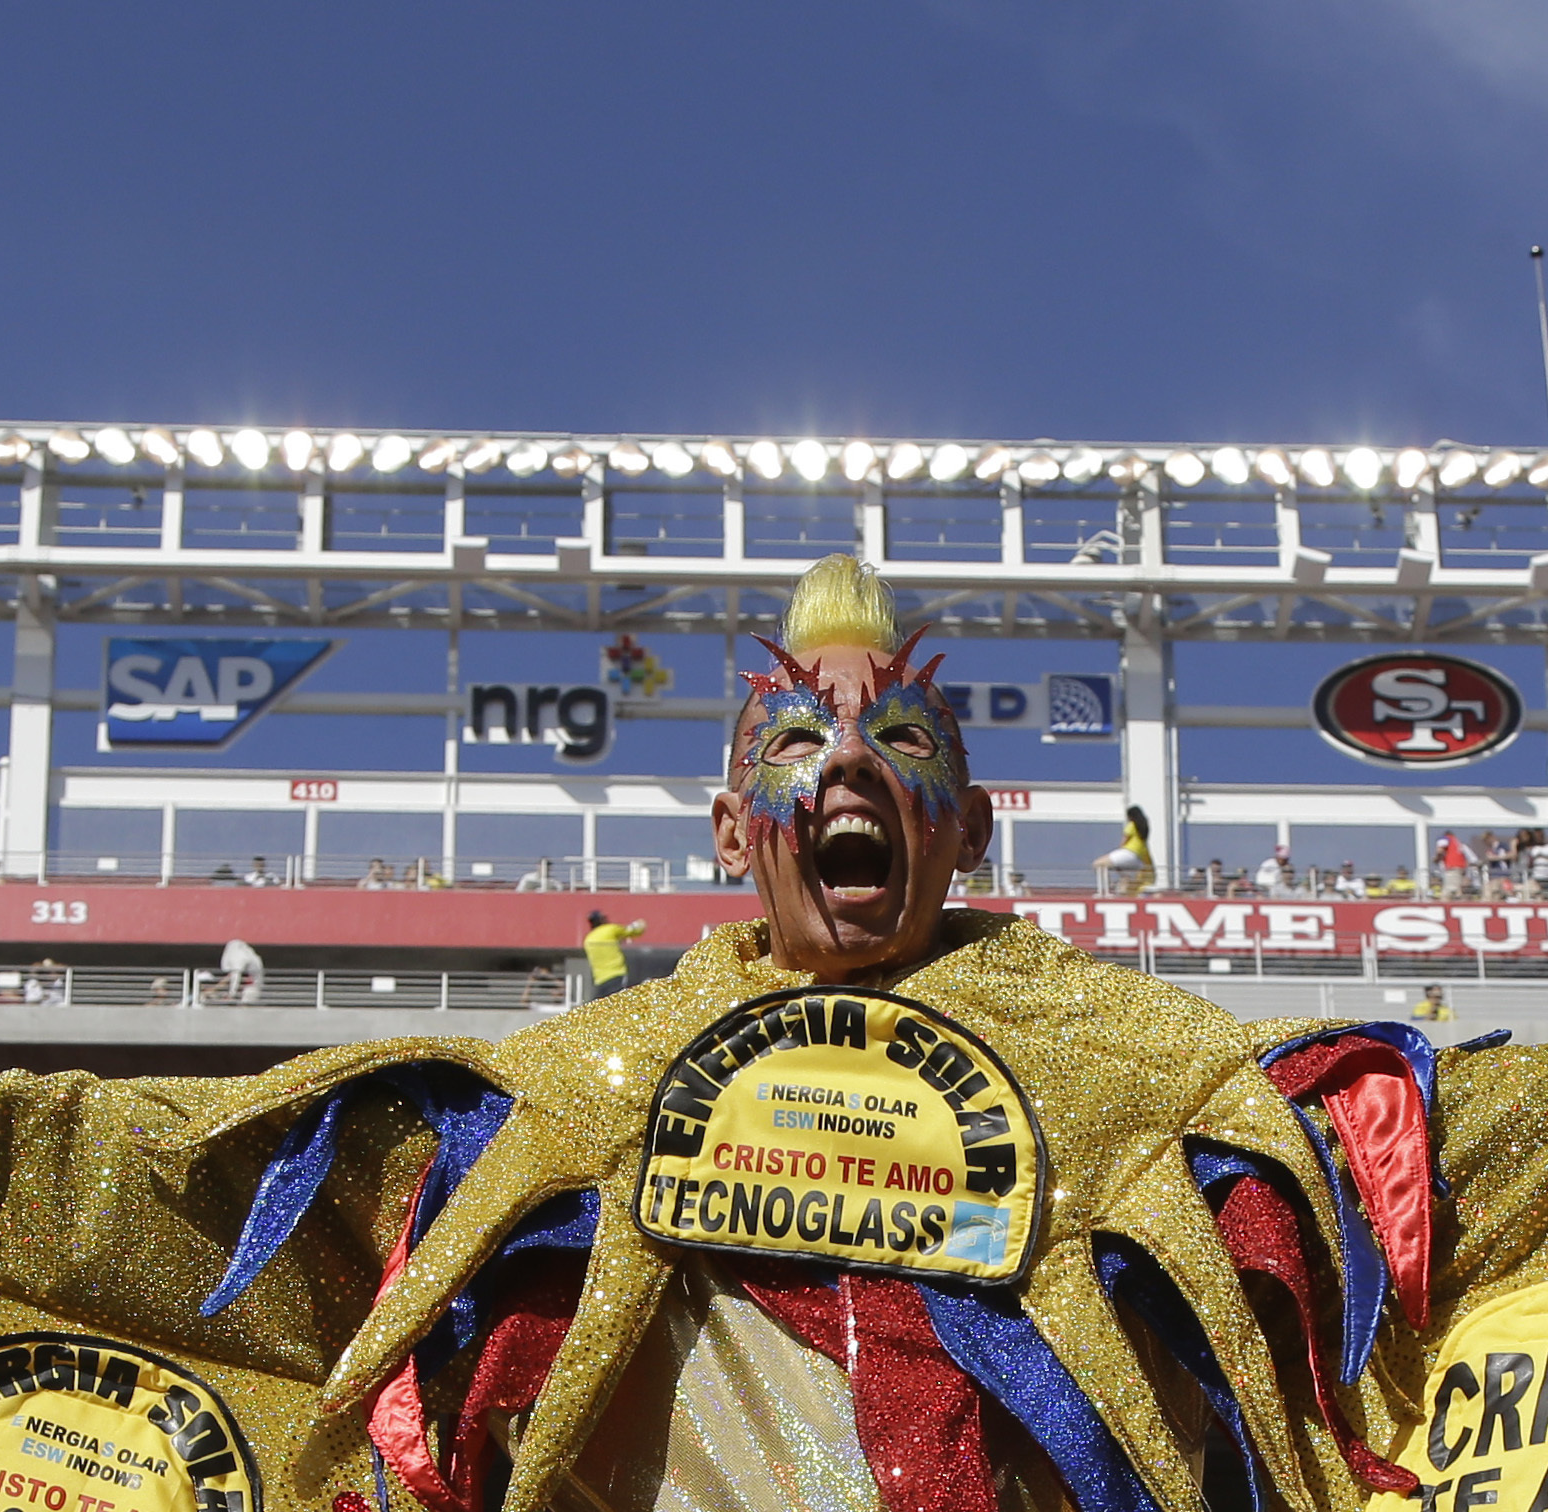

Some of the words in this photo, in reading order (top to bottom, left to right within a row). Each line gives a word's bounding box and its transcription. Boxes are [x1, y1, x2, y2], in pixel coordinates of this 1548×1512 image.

[108, 655, 273, 721] SAP
[471, 684, 608, 757] nrg
[293, 782, 336, 799] 410
[991, 791, 1028, 809] 11
[31, 900, 88, 924] 313
[1013, 902, 1336, 950] TIME
[654, 998, 867, 1157] ENERGIA
[885, 1016, 1017, 1197] SOLAR
[713, 1141, 827, 1181] CRISTO
[837, 1155, 876, 1187] TE
[884, 1161, 954, 1196] AMO
[650, 1174, 948, 1256] TECNOGLASS
